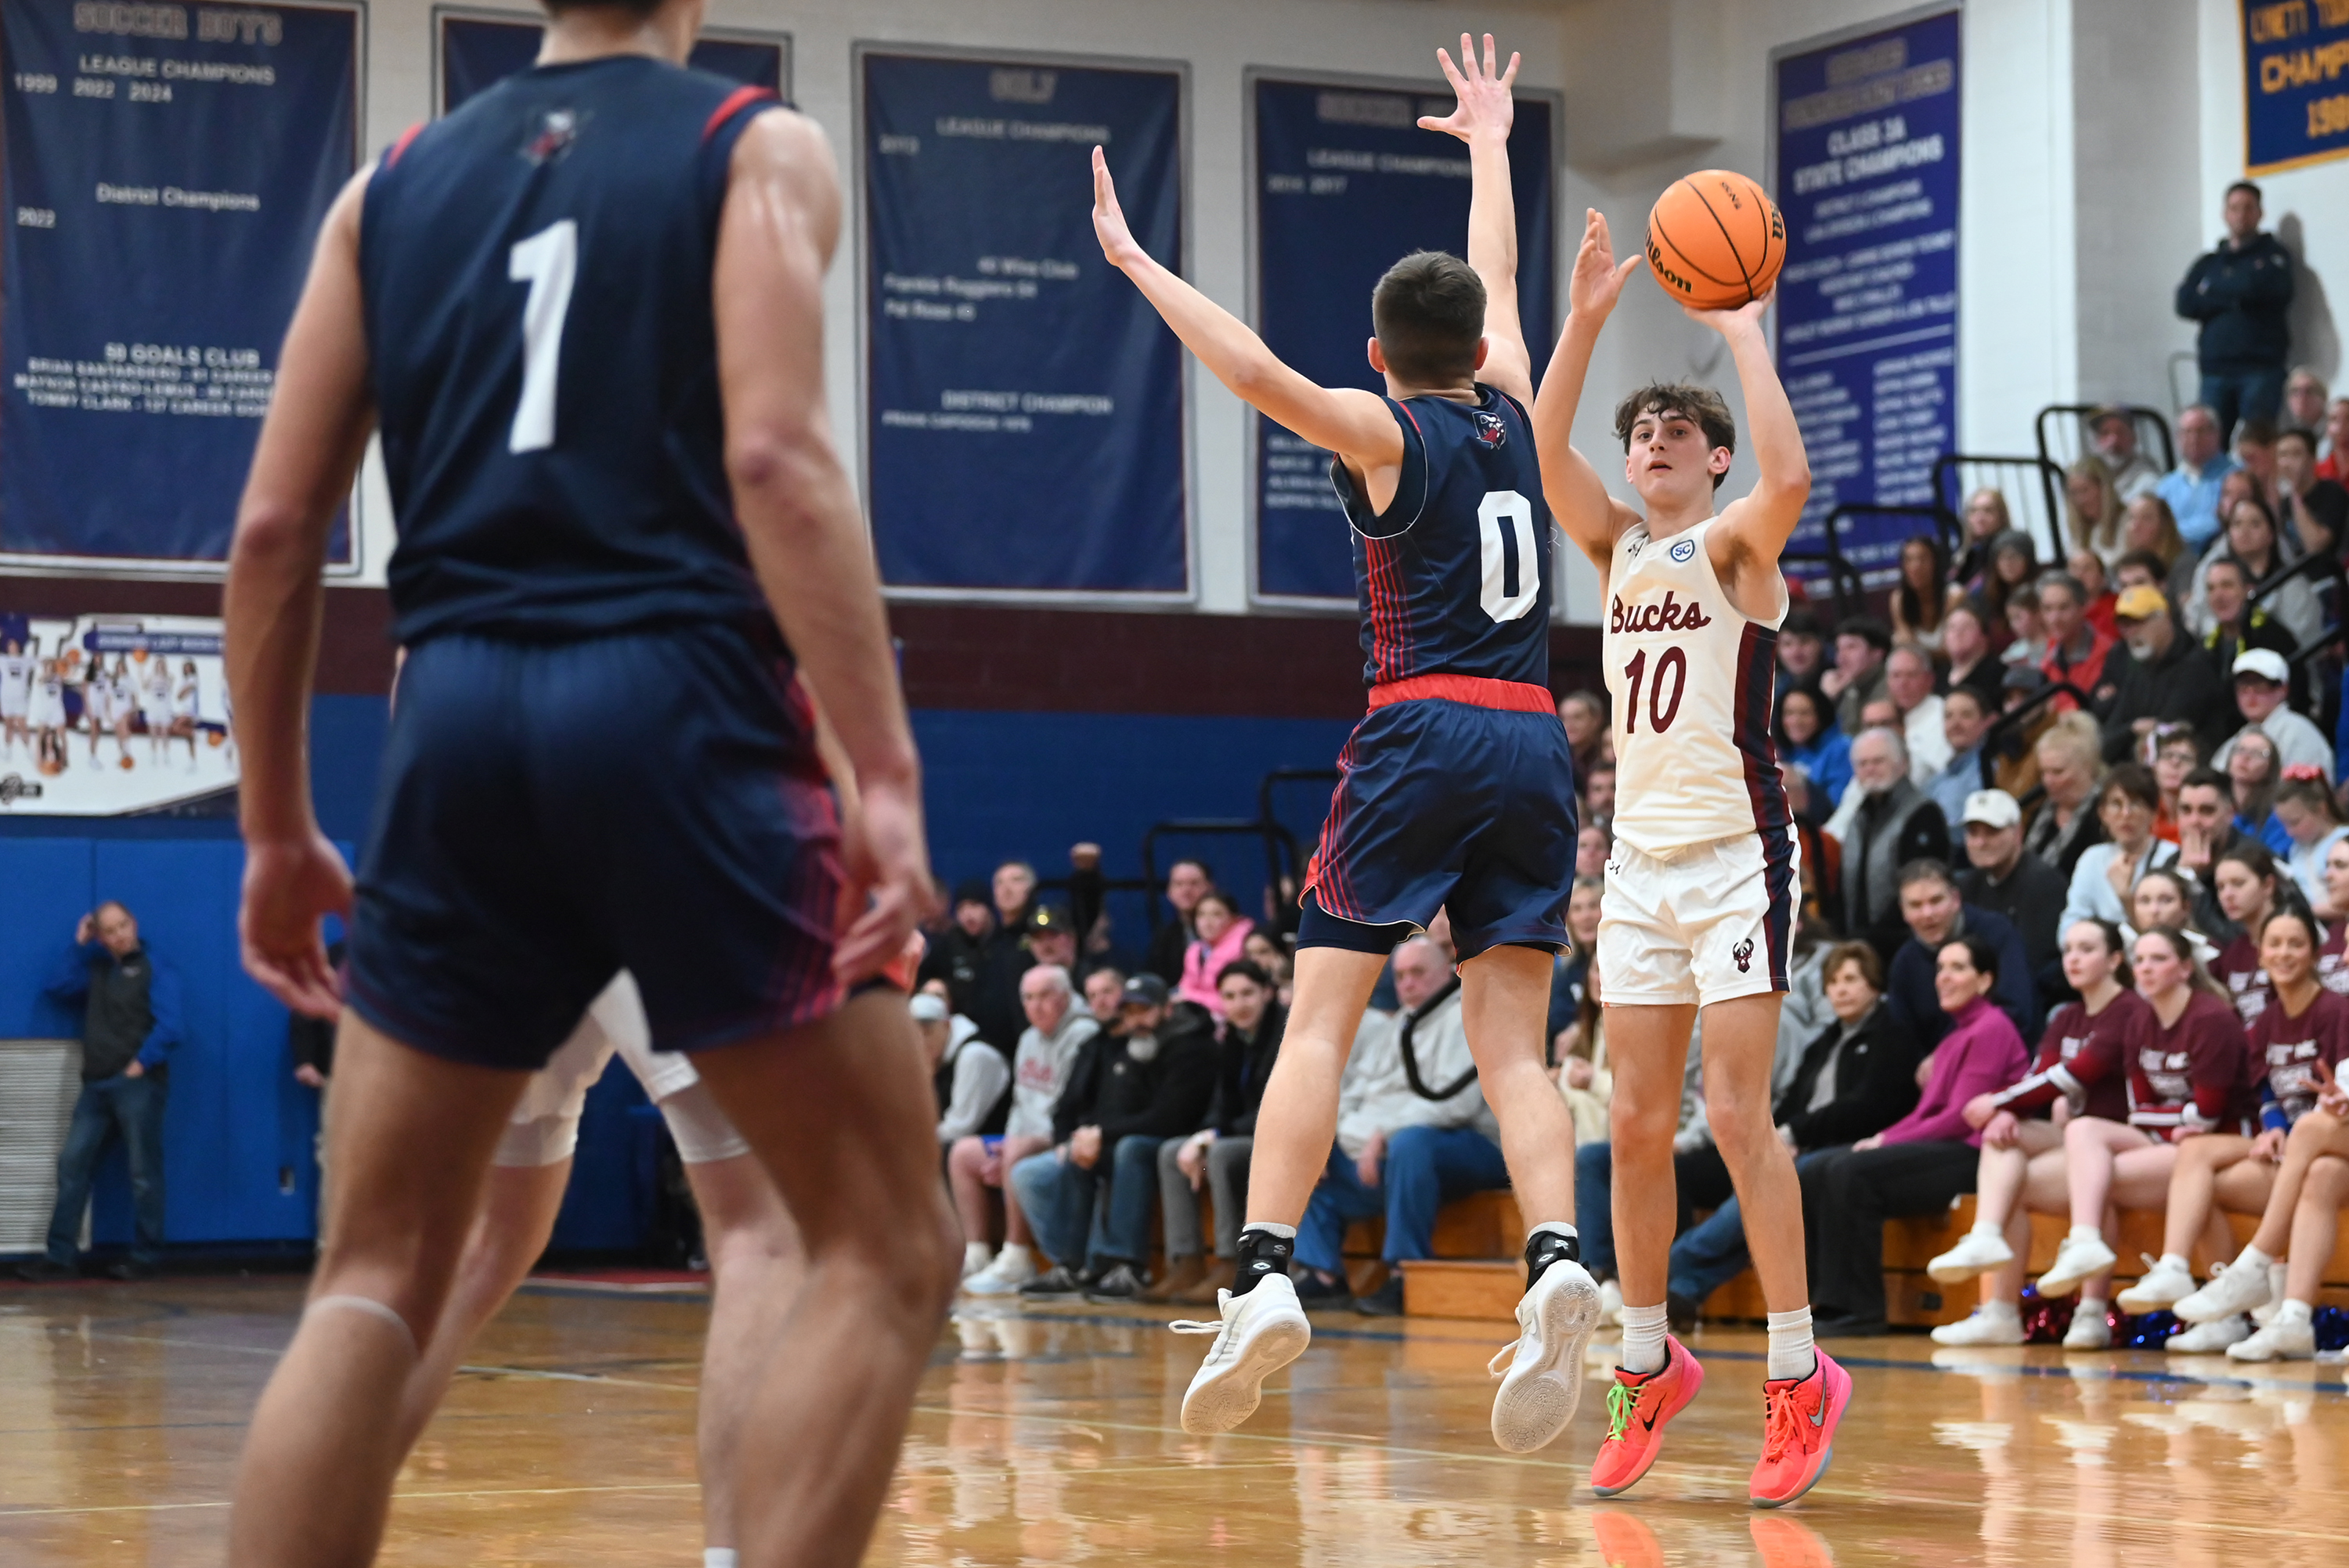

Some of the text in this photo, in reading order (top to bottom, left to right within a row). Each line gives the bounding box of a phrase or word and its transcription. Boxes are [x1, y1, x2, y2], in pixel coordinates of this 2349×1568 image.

[75, 2, 282, 45] SOCCER BOYS
[80, 55, 275, 85] LEAGUE CHAMPIONS
[73, 77, 115, 99] 2022
[129, 82, 173, 102] 2024
[936, 117, 1111, 144] LEAGUE CHAMPIONS
[1827, 115, 1907, 157] CLASS 3A
[1306, 148, 1375, 171] LEAGUE
[1792, 133, 1945, 194] STATE CHAMPIONS
[96, 182, 260, 212] District Champions
[16, 207, 56, 228] 2022
[509, 218, 577, 454] 1
[28, 357, 74, 374] BRIAN
[130, 344, 200, 366] GOALS
[204, 347, 260, 367] CLUB
[28, 391, 77, 407] TOMMY
[81, 395, 132, 412] CLARK
[170, 400, 232, 416] CAREER
[941, 390, 1113, 415] DISTRICT CHAMPION
[1478, 490, 1540, 623] 0
[1674, 543, 1691, 557] SC
[1611, 591, 1712, 634] Bucks
[1624, 646, 1687, 734] 10
